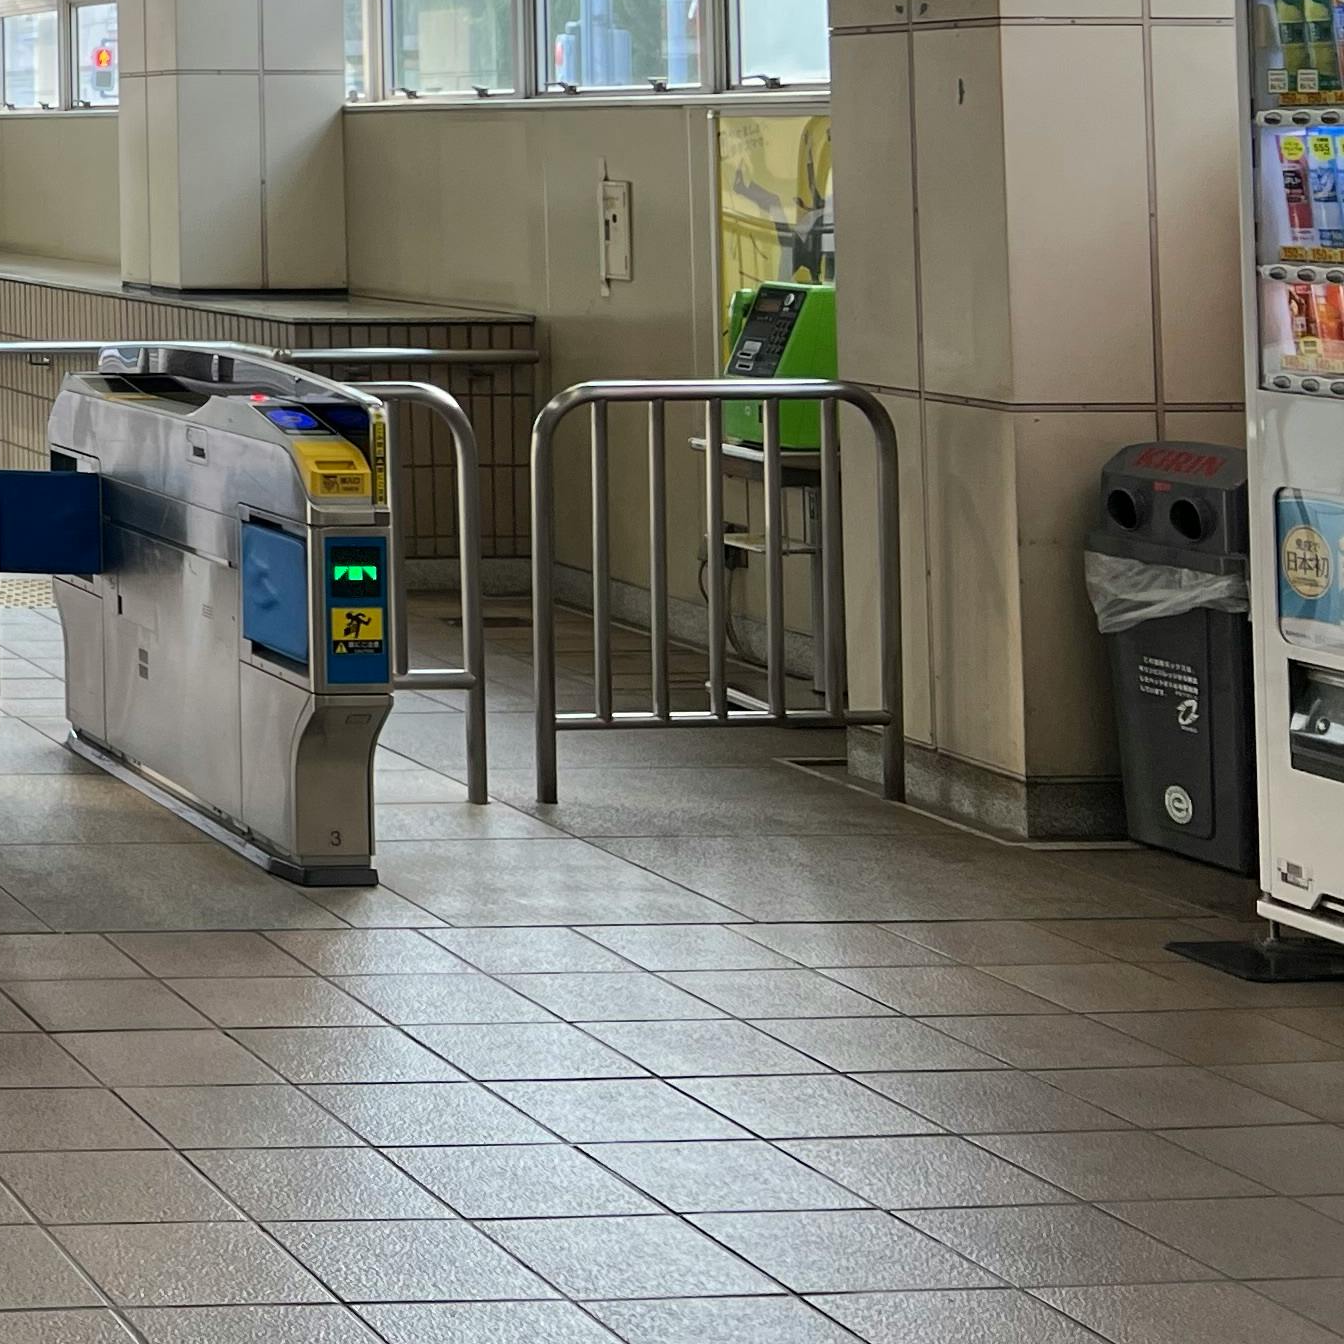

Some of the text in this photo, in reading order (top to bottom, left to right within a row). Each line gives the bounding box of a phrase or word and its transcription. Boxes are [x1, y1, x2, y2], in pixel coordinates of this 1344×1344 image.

[1135, 447, 1227, 479] KIRIN
[1286, 551, 1330, 578] 日本初
[330, 830, 342, 847] 3
